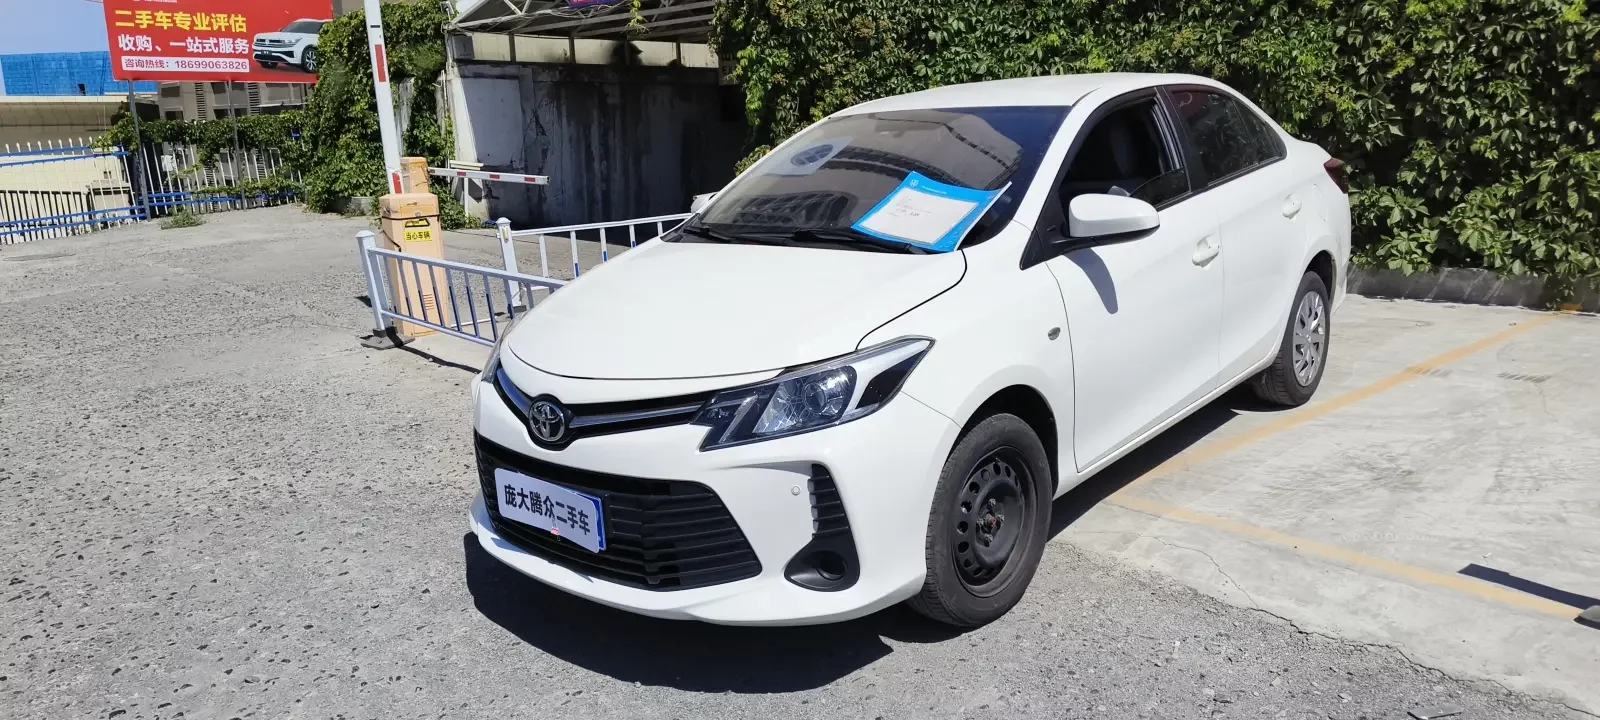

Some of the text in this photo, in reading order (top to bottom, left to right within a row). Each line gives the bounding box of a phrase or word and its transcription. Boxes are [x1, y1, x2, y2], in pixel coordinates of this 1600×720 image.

[115, 10, 247, 33] 二手车专业评估
[118, 34, 249, 54] 收购、一站式服务
[405, 231, 431, 240] 当心车辆
[503, 483, 591, 536] 庞大腾众二手车
